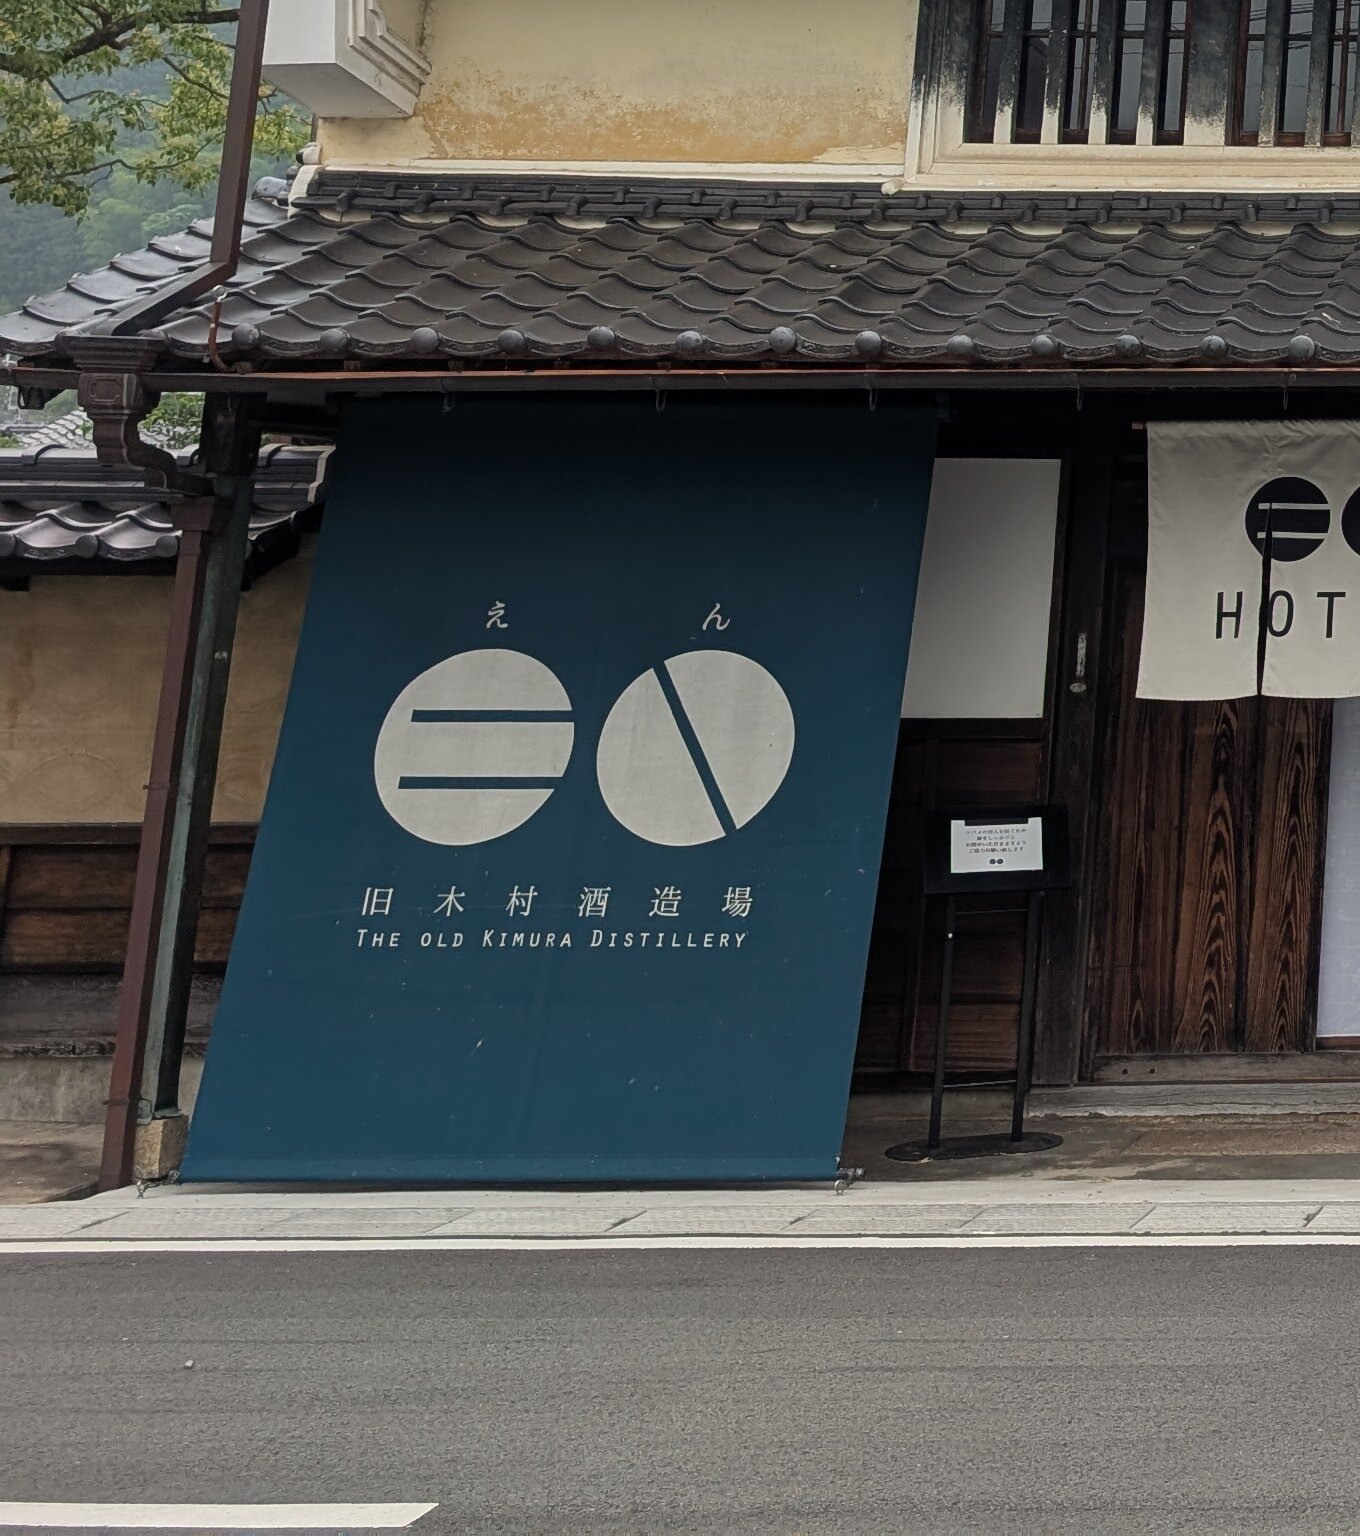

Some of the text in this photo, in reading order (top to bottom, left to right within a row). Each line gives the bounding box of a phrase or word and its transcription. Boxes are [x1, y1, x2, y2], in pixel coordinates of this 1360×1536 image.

[361, 885, 754, 918] 旧木村酒造場
